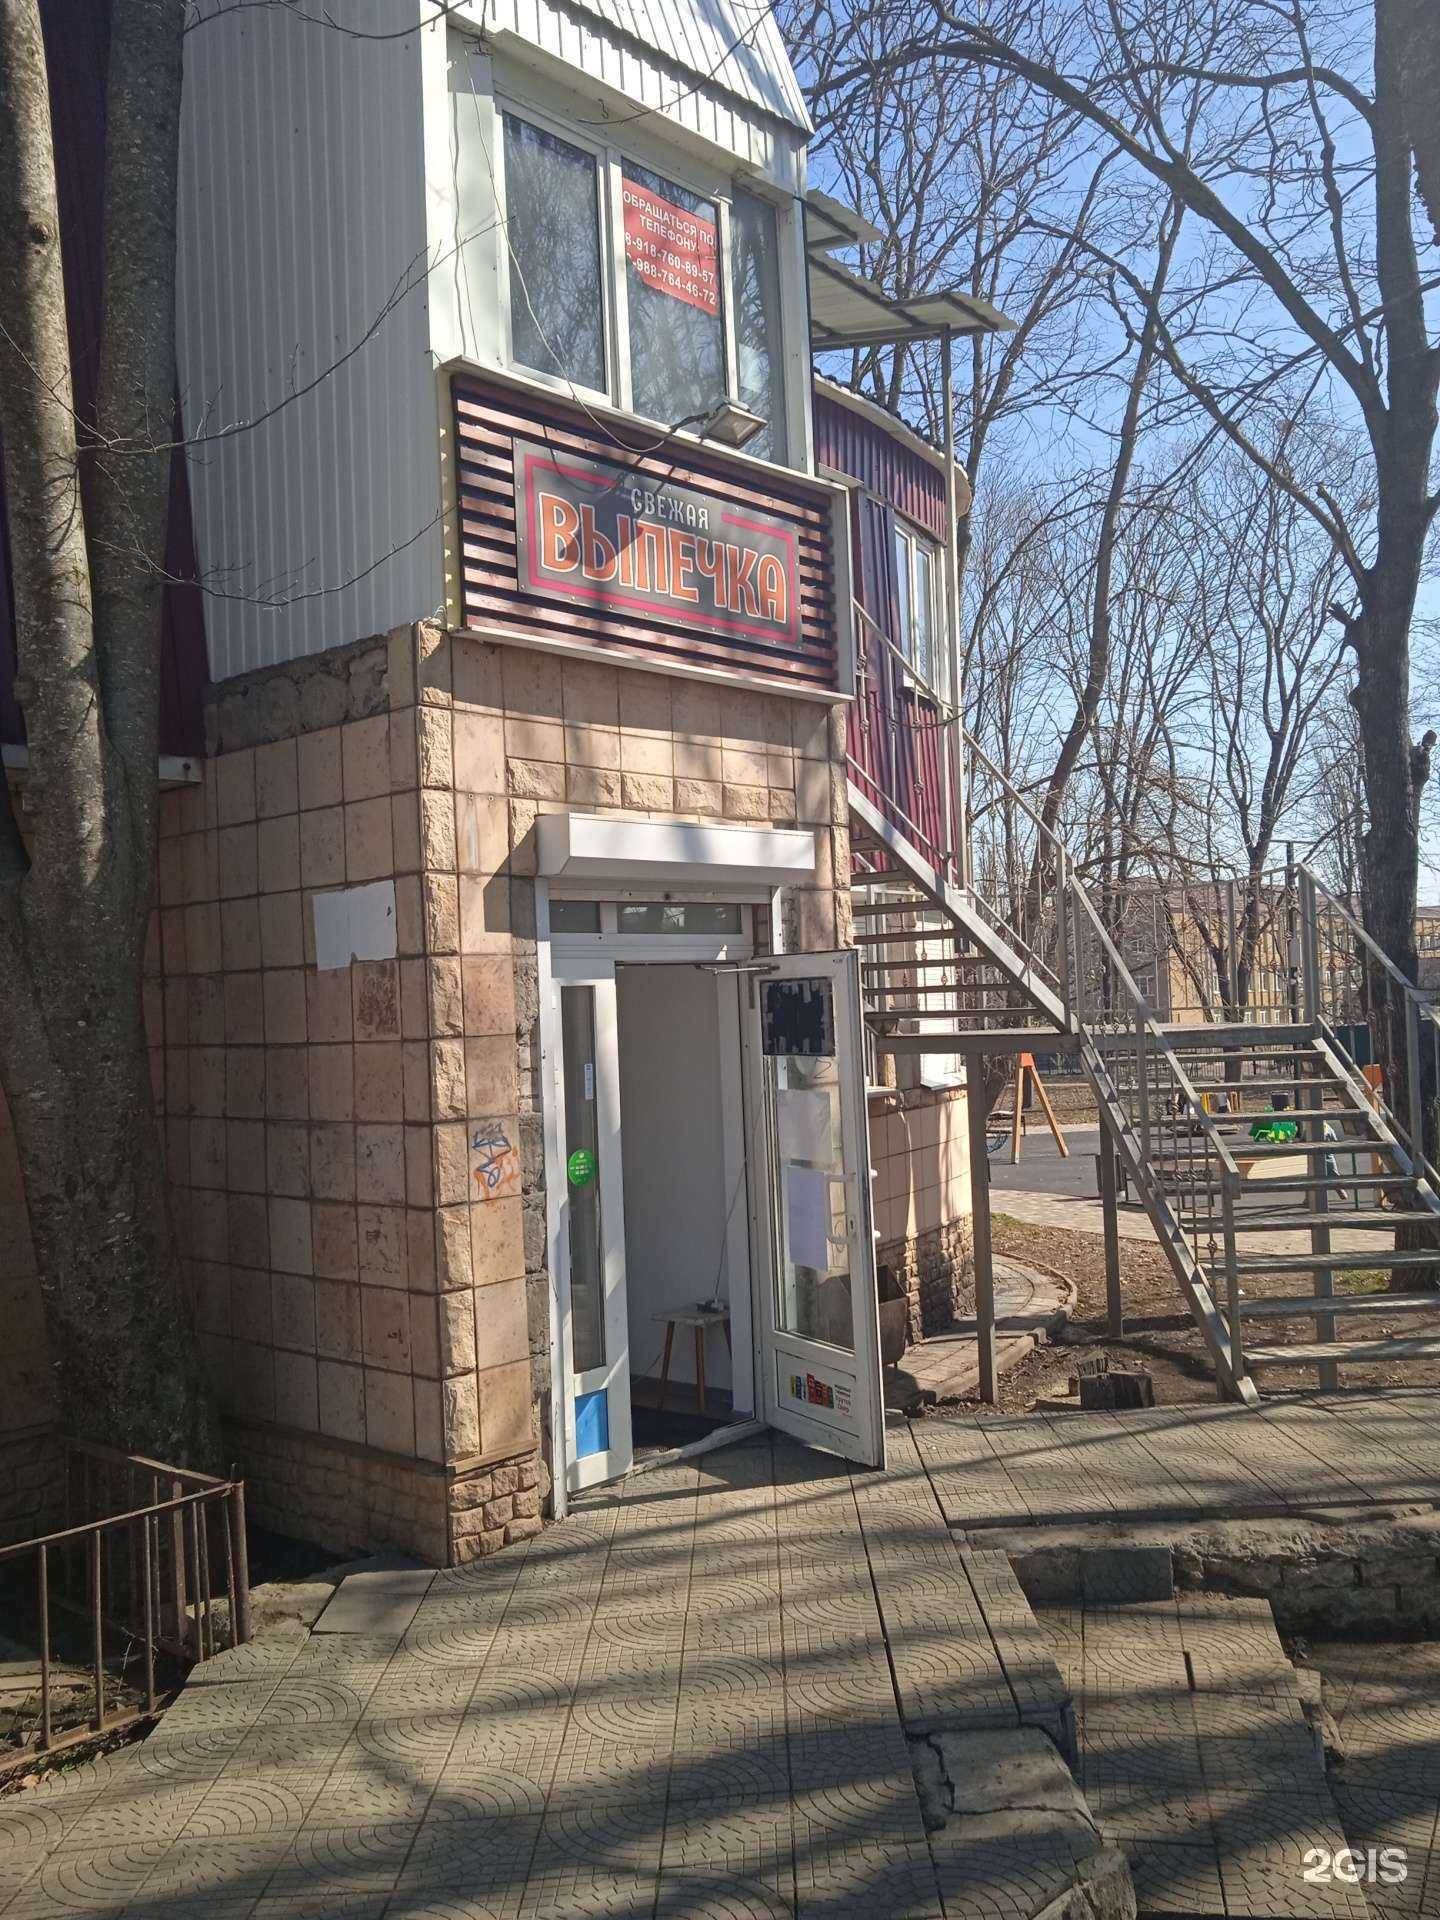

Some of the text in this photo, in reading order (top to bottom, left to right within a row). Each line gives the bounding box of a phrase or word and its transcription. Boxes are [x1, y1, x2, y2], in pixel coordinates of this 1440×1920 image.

[623, 191, 714, 246] ОБРАЩАТЬСЯ ПО
[625, 232, 714, 285] 8-918-760-89-57
[627, 252, 715, 304] -988-764-46-72
[630, 488, 709, 530] СВЕЖАЯ
[538, 492, 786, 624] ВЫПЕЧКА
